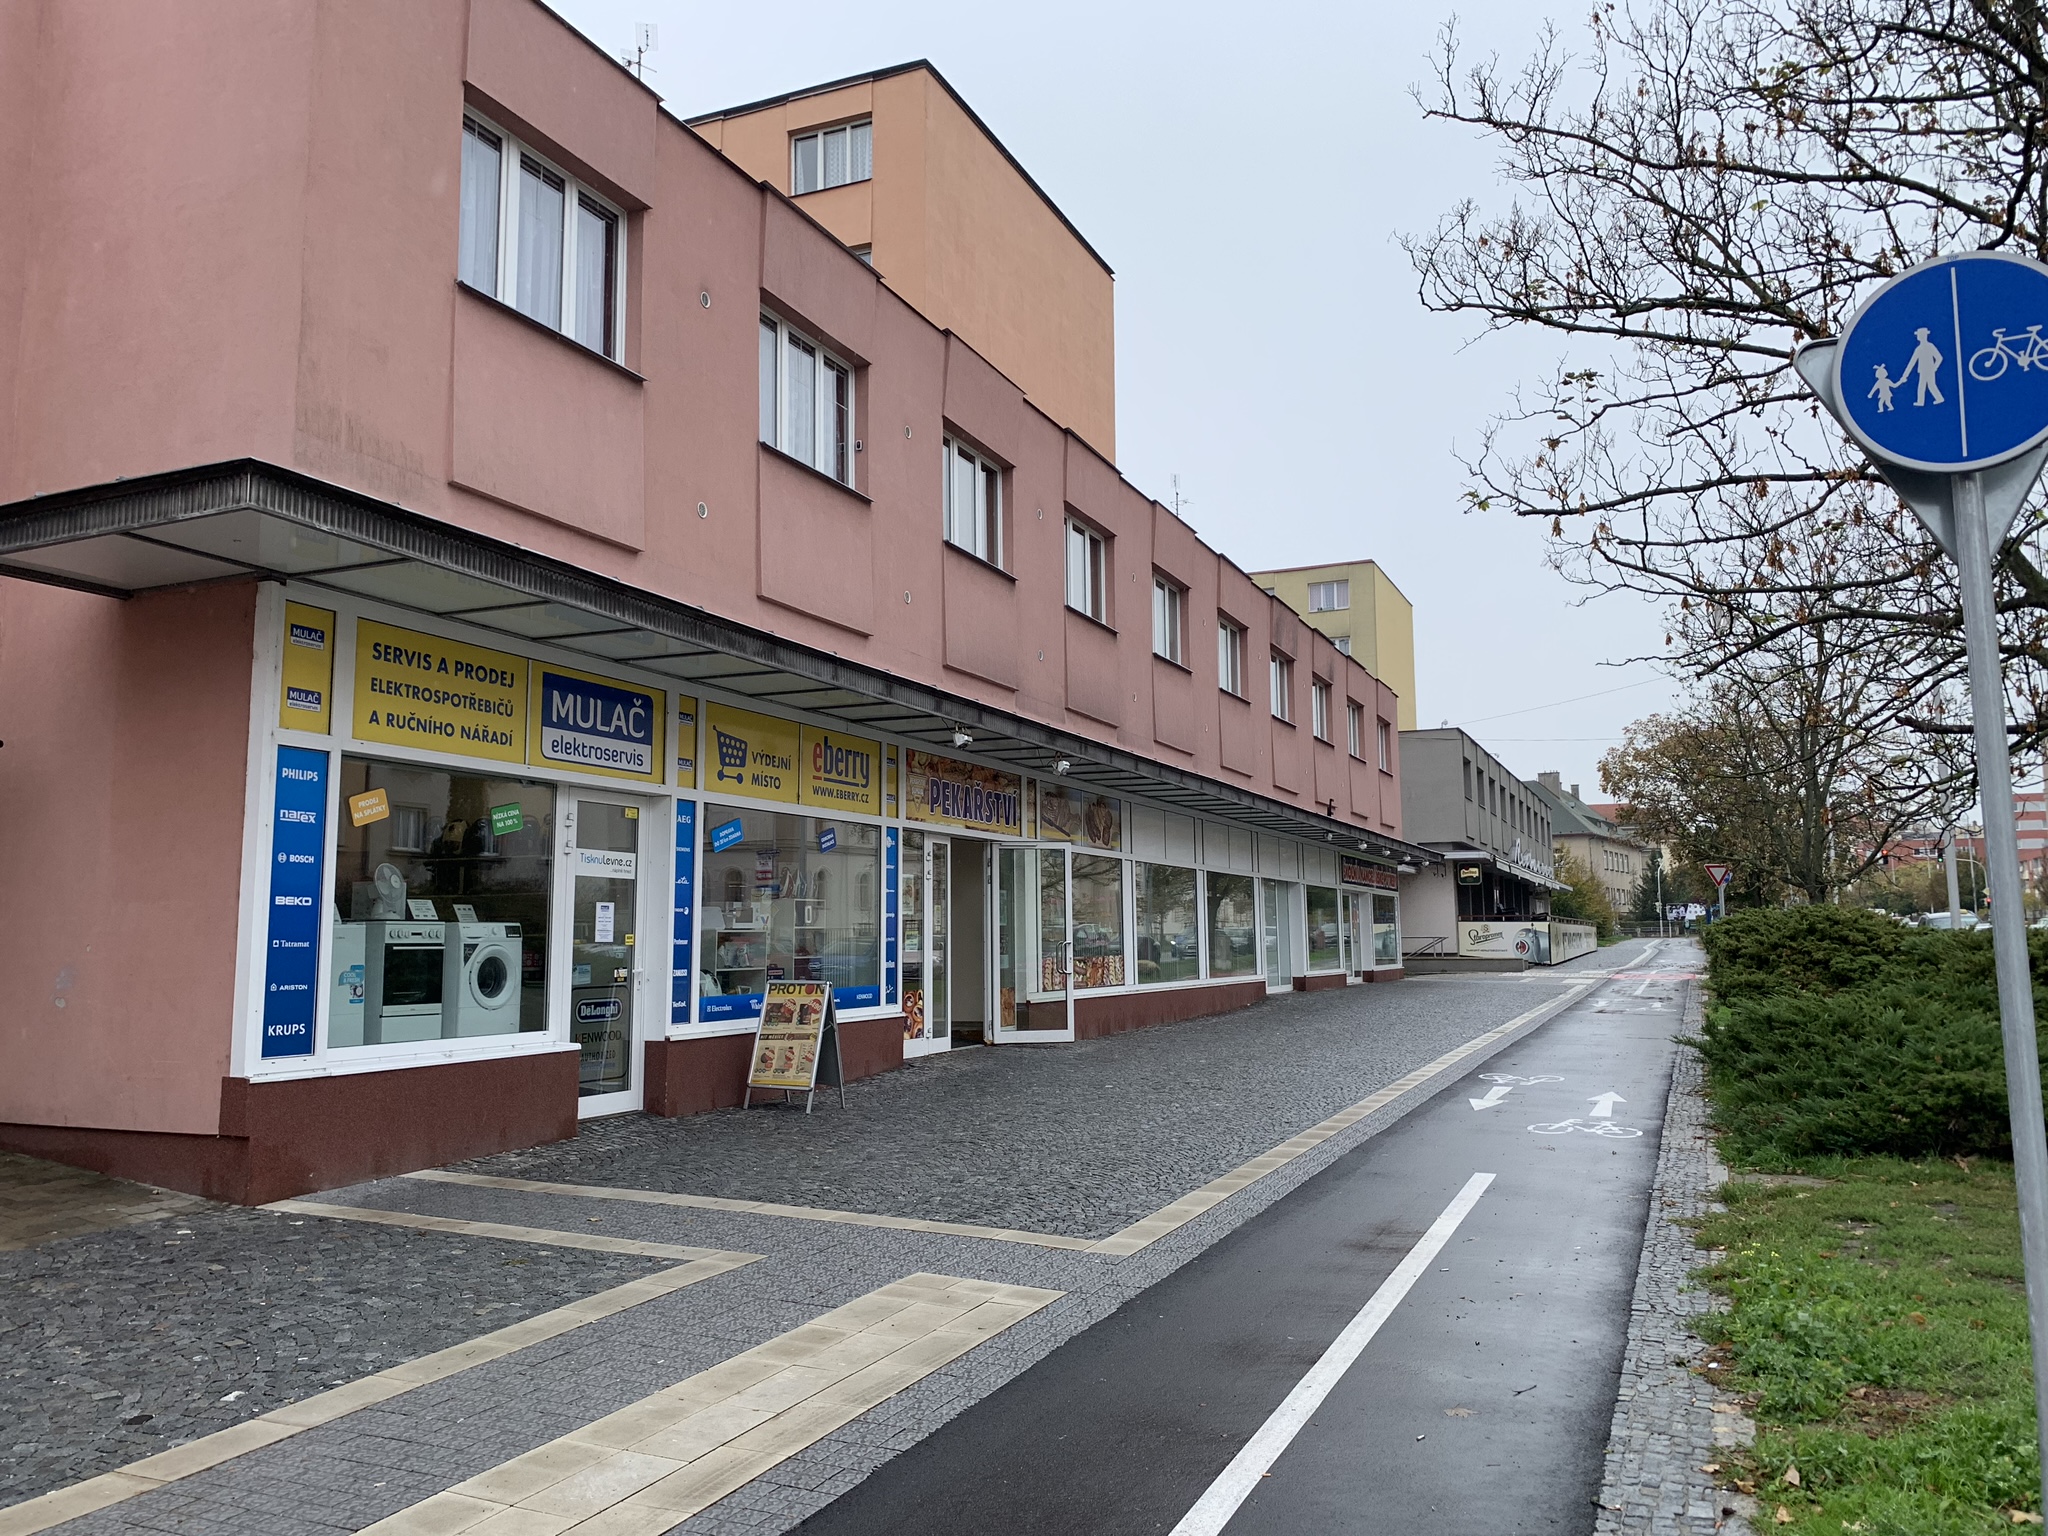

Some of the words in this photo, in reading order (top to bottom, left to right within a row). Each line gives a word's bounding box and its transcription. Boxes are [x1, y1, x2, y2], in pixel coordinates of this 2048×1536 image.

[293, 627, 323, 642] MULAČ
[372, 642, 432, 671] SERVIS
[437, 659, 450, 675] A
[455, 662, 515, 689] PRODEJ
[289, 690, 320, 704] MULAČ
[371, 677, 514, 717] ELEKTROSPOTŘEBIČŮ
[552, 690, 645, 738] MULAČ
[369, 710, 380, 725] A
[387, 713, 456, 738] RUČNÍHO
[460, 719, 514, 747] NÁŘADÍ
[551, 738, 644, 766] elektroservis
[751, 748, 791, 771] VÝDEJNÍ
[813, 735, 870, 788] eberry
[282, 768, 318, 782] PHILIPS
[751, 771, 781, 790] MÍSTO
[812, 784, 870, 804] WWW.EBERRY.CZ
[929, 777, 1018, 828] PEKAŘSTVÍ
[280, 808, 316, 824] narex
[677, 815, 691, 824] AEG
[289, 854, 315, 863] BOSCH
[580, 852, 633, 867] Tisknulevne.cz
[275, 895, 312, 906] BEKO
[280, 939, 310, 948] Tatramat
[268, 1023, 306, 1037] KRUPS
[575, 1030, 622, 1044] KENWOOD
